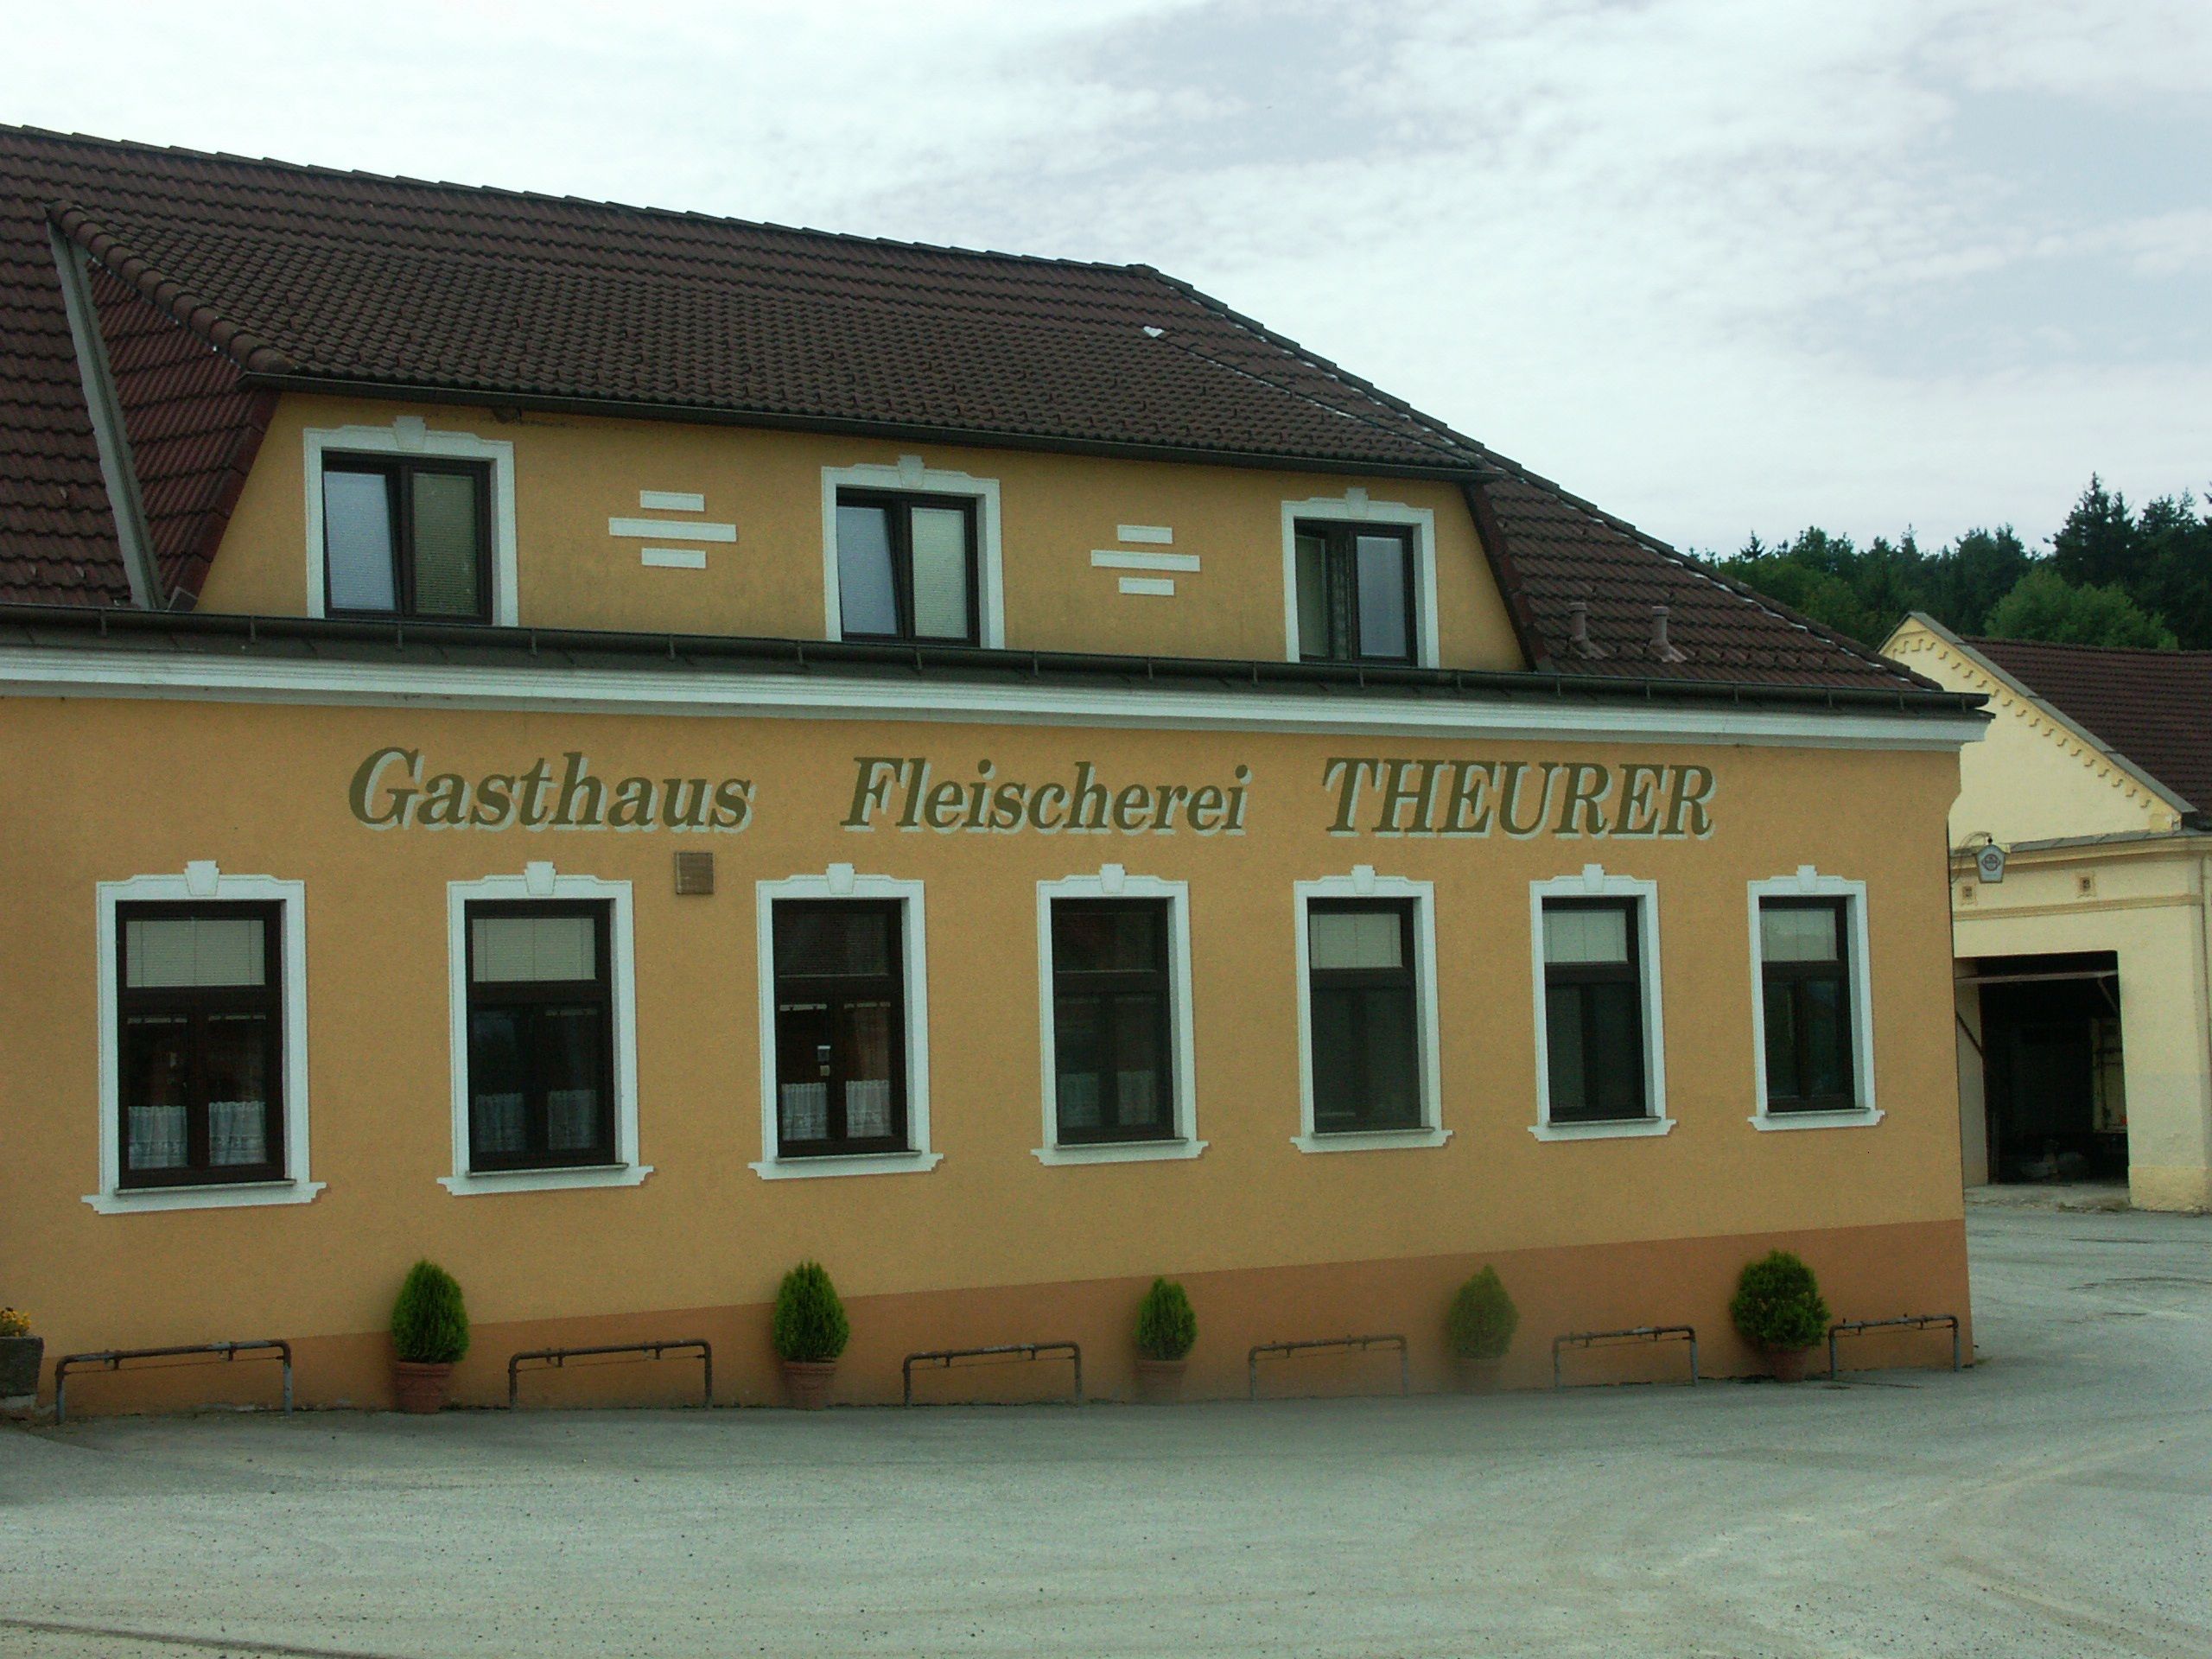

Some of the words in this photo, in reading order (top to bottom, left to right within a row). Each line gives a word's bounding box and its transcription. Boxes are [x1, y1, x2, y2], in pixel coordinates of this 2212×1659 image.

[348, 747, 752, 832] Gasthaus
[840, 756, 1251, 835] Fleischerei
[1321, 756, 1714, 838] THEURER
